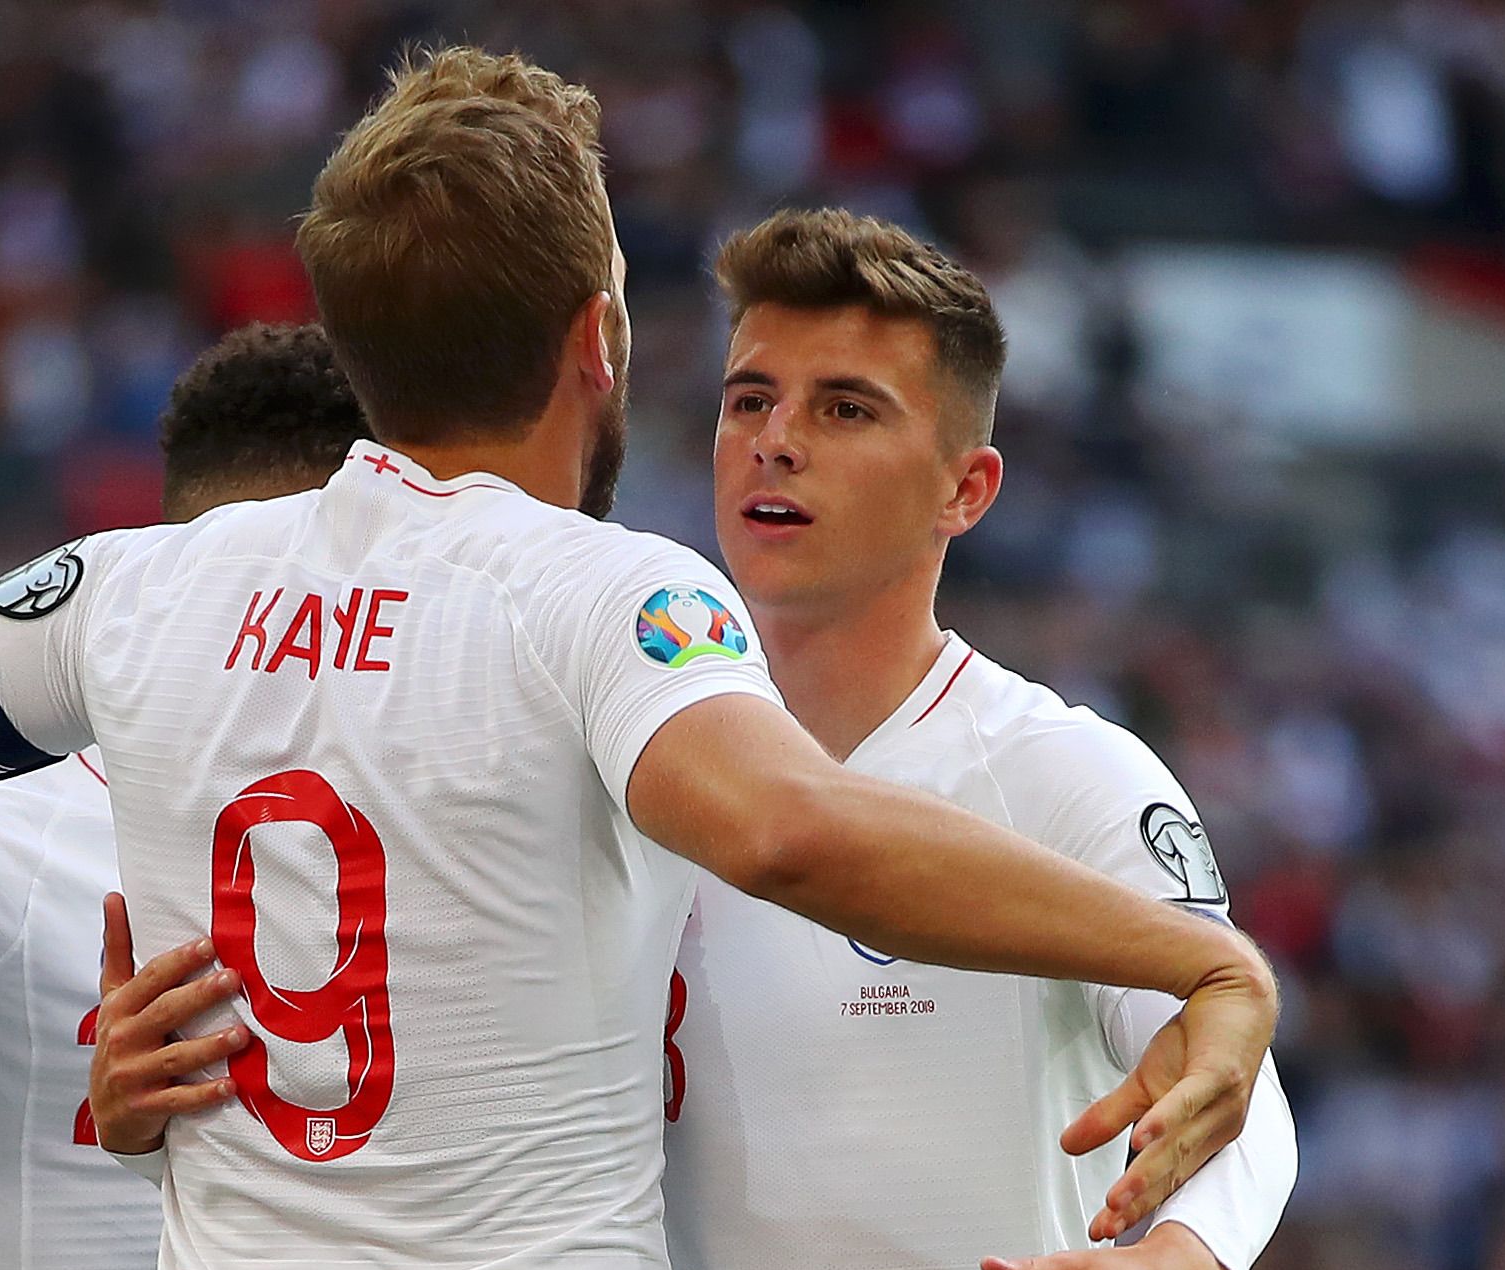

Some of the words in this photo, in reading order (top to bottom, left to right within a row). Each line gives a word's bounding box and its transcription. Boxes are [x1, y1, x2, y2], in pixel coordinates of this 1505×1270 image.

[210, 769, 396, 1162] 9
[860, 984, 911, 999] BULGARIA
[840, 1003, 848, 1016] 7
[849, 1001, 908, 1016] SEPTEMBER
[910, 999, 935, 1014] 2019
